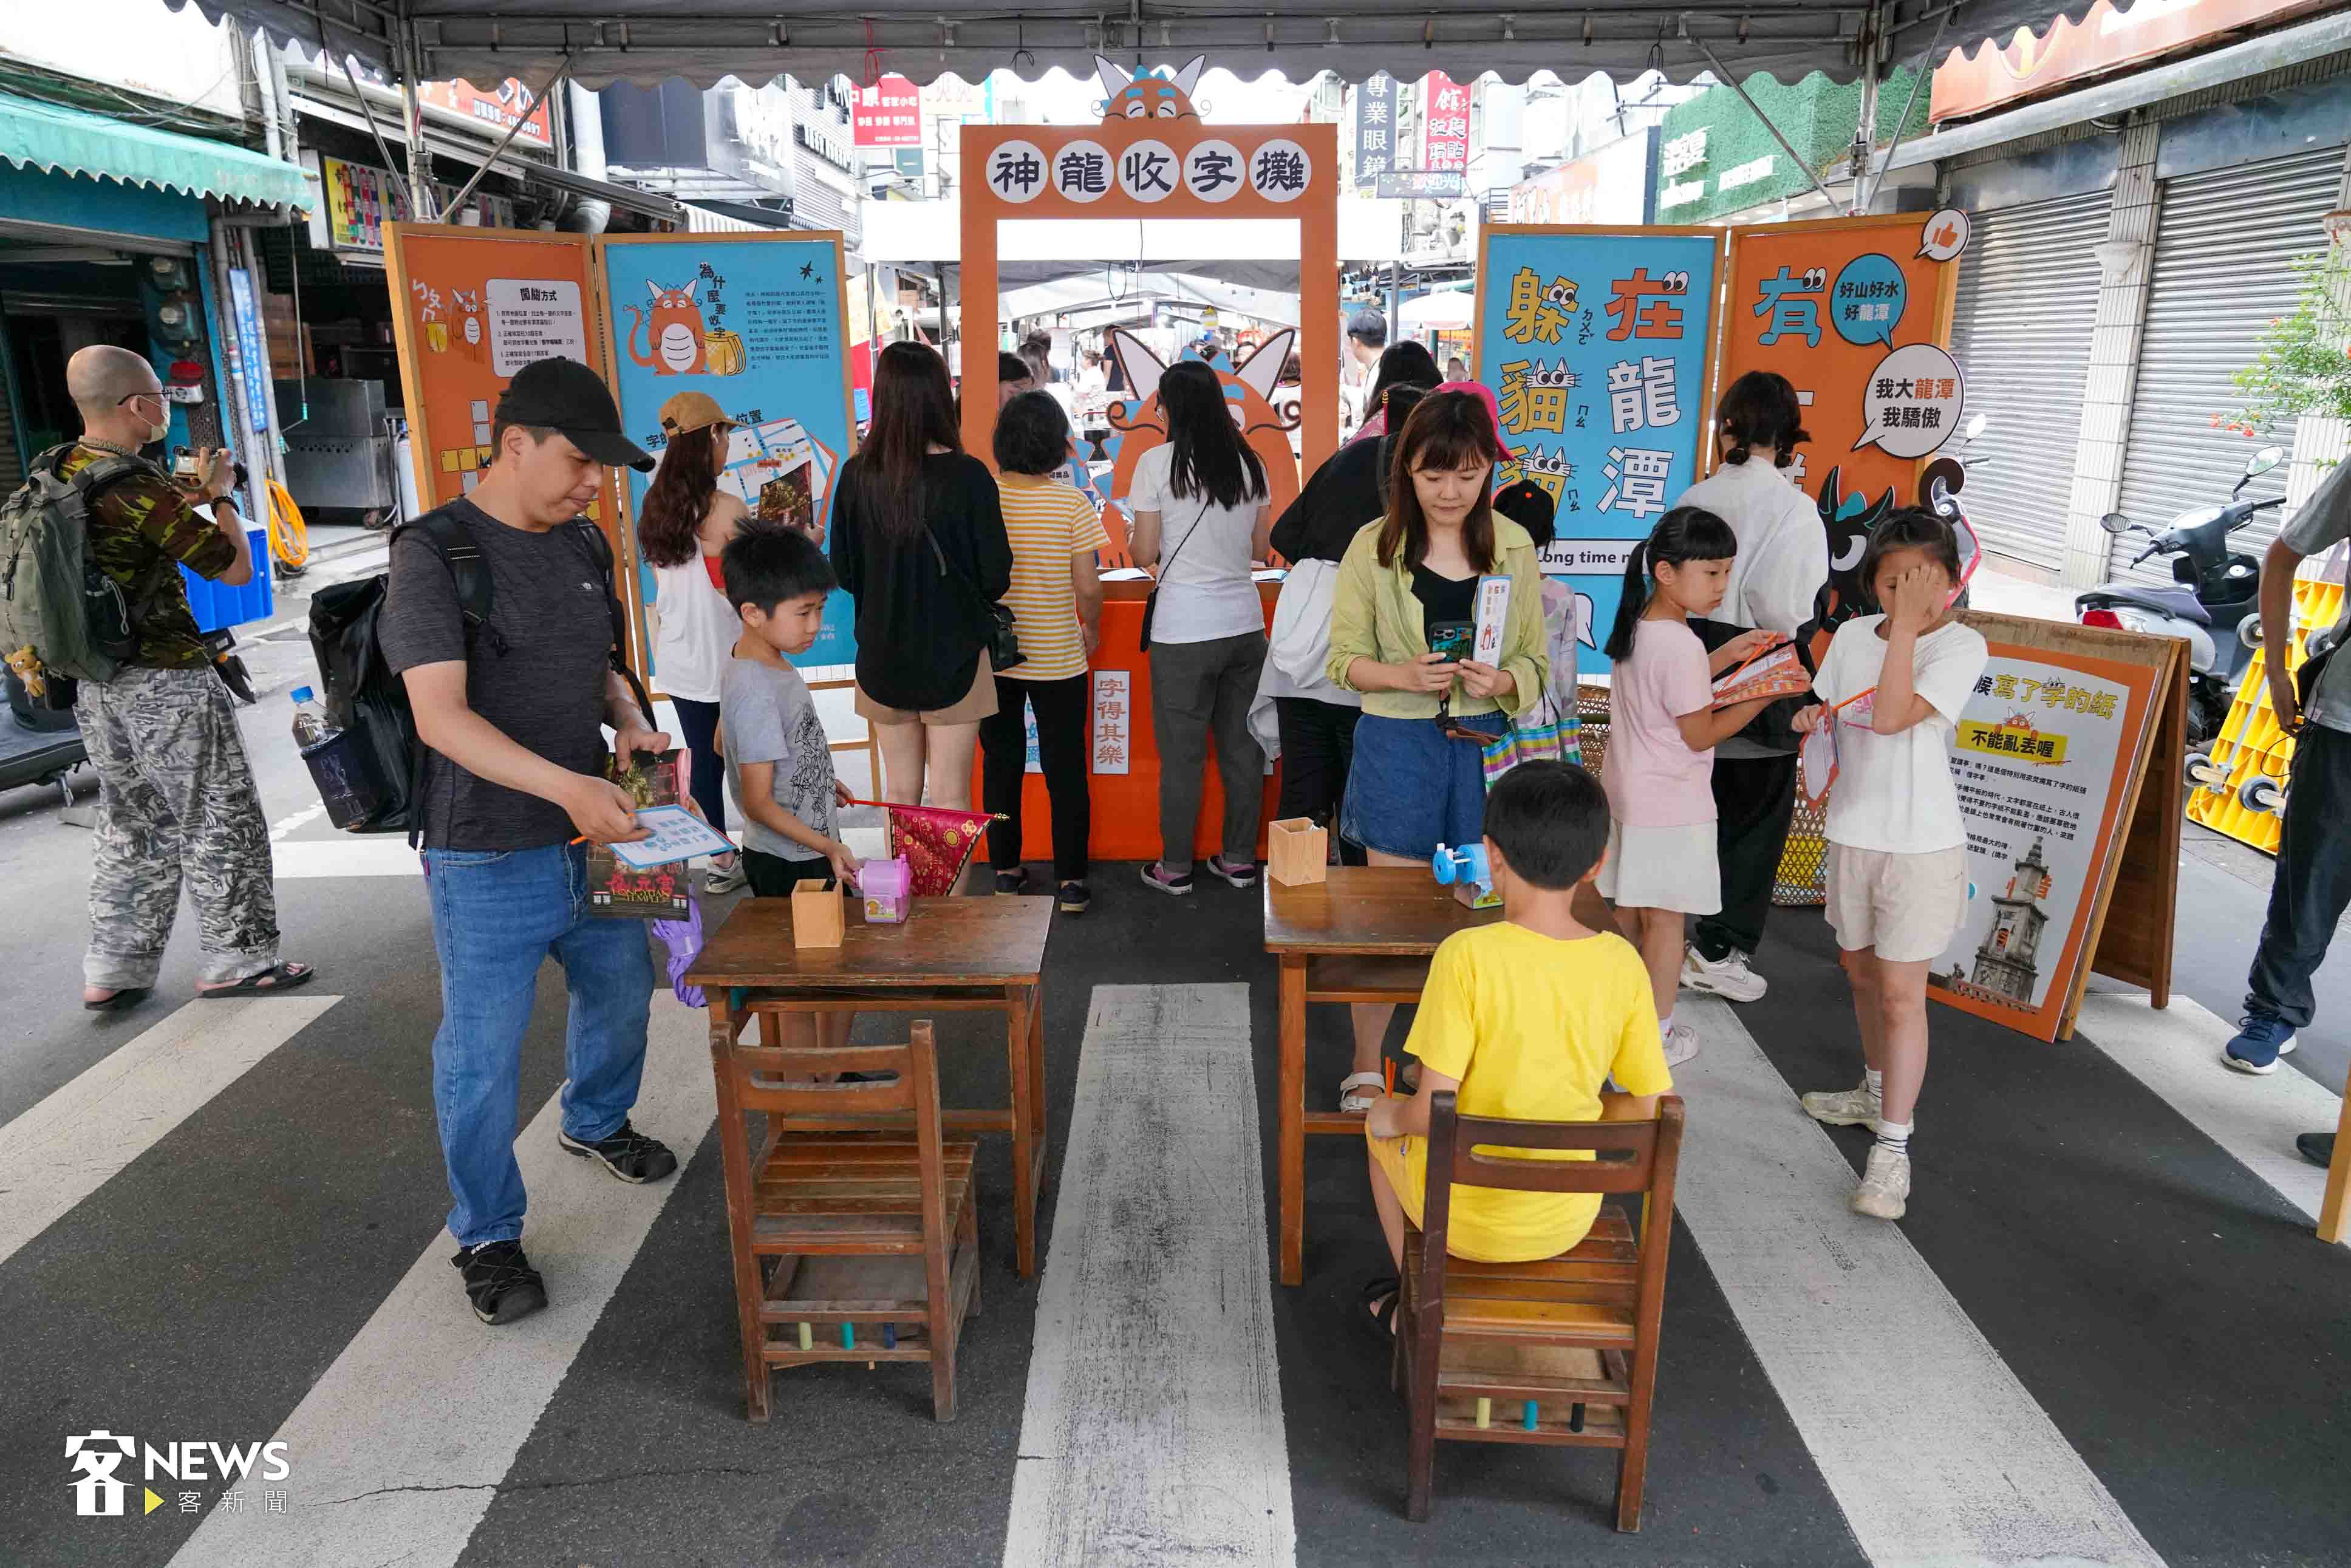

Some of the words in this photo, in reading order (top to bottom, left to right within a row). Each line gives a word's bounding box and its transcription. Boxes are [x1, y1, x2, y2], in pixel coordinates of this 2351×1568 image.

[1362, 75, 1388, 178] 專業眼鏡
[993, 150, 1305, 193] 神龍收字攤
[520, 287, 558, 301] 闖關方式
[699, 263, 726, 338] 為什麼要收字
[1840, 280, 1899, 299] 好山好水
[1845, 304, 1889, 321] 好龍潭
[1876, 378, 1954, 400] 我大龍潭
[1883, 407, 1941, 429] 我驕傲
[1579, 551, 1616, 564] time
[1096, 678, 1127, 765] 字得其樂
[1971, 729, 2055, 758] 不能亂丟喔
